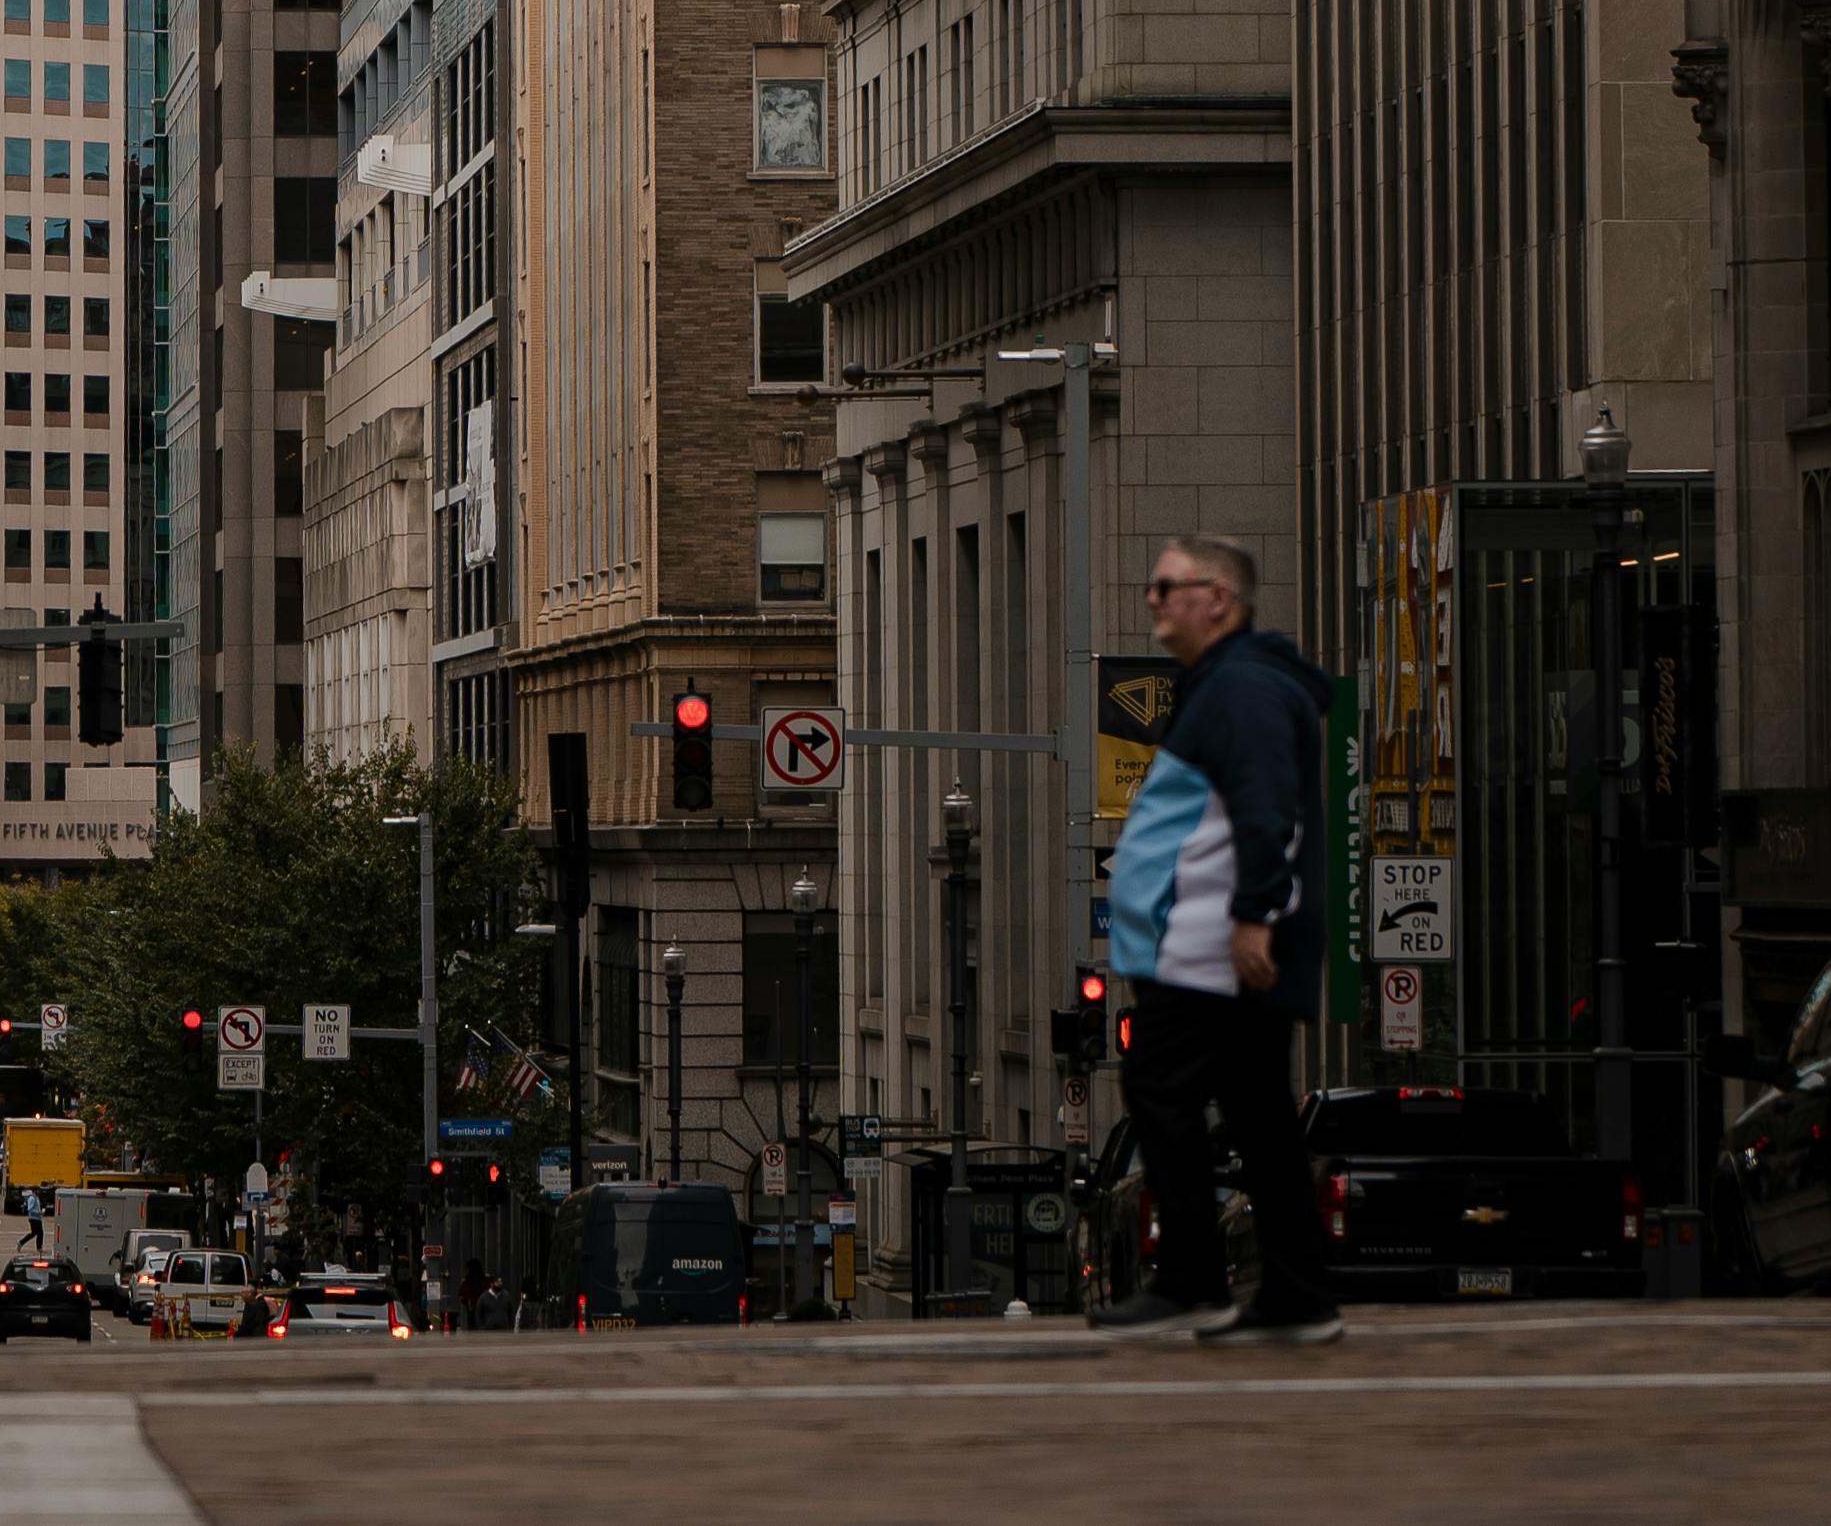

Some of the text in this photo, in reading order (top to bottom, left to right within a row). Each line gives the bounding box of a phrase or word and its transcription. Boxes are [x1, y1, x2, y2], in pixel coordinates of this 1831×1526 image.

[3, 823, 156, 841] FIFTH AVENUE PLA
[1384, 865, 1442, 884] STOP
[1394, 889, 1430, 901] HERE
[1412, 917, 1431, 929] ON
[1400, 932, 1443, 952] RED
[315, 1009, 338, 1022] NO
[314, 1024, 340, 1034] TURN
[319, 1035, 334, 1044] ON
[317, 1046, 336, 1056] RED
[225, 1058, 257, 1069] EXCEPT
[448, 1127, 505, 1136] Smithfield St
[592, 1160, 627, 1170] verizon
[672, 1258, 723, 1271] amazon
